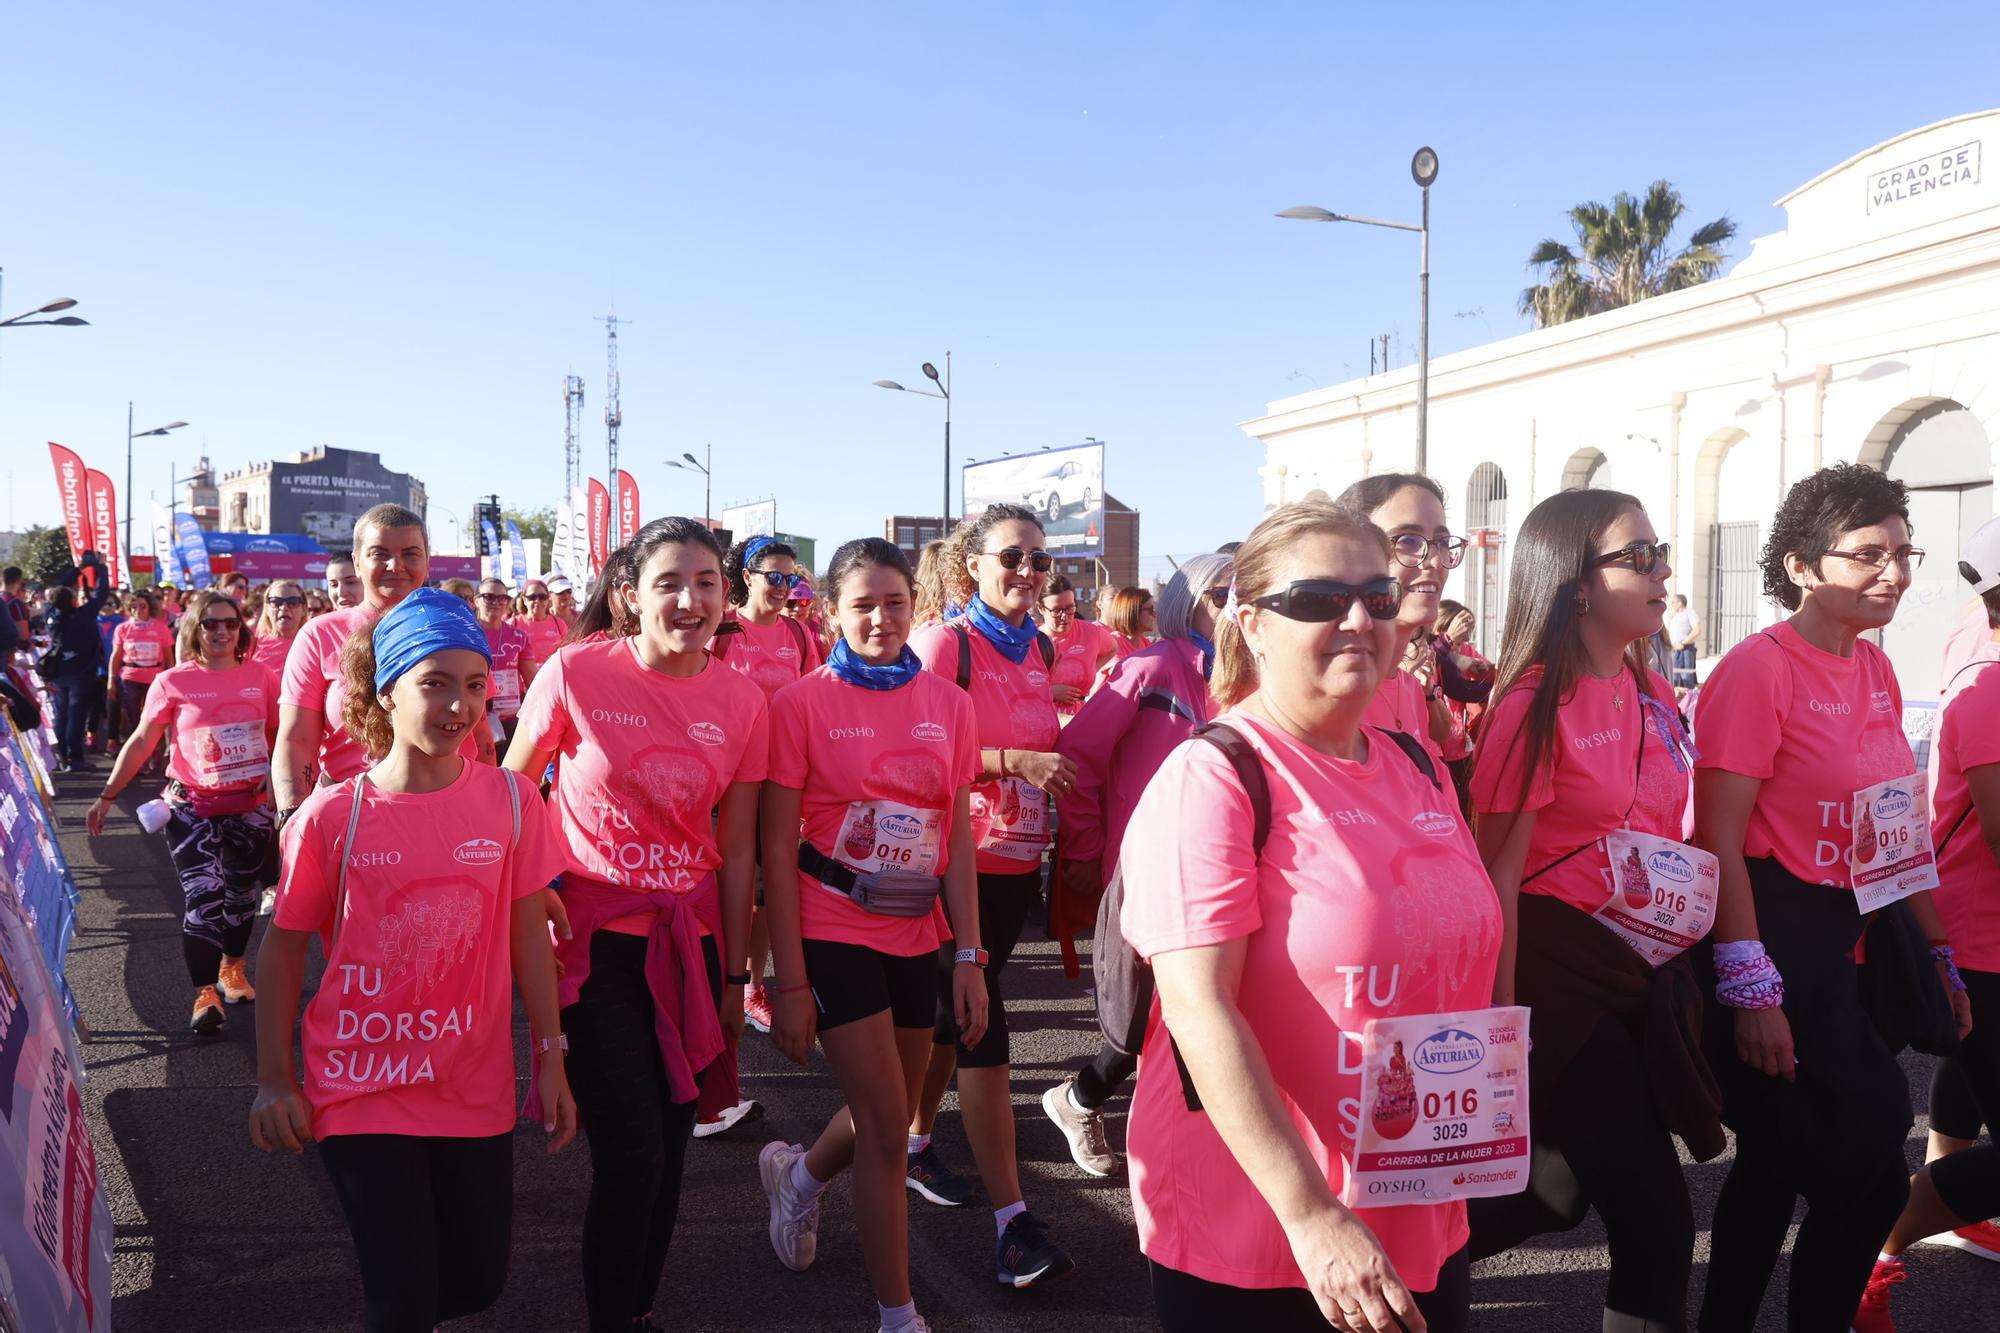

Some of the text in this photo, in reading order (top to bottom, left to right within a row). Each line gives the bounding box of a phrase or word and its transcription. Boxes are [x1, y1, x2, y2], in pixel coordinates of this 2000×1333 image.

[1877, 150, 1969, 189] GRAO DE
[1873, 167, 1971, 207] VALENCIA
[294, 475, 329, 487] PUERTO
[591, 708, 647, 728] OYSHO
[829, 727, 875, 740] OYSHO
[1574, 727, 1621, 750] OYSHO
[223, 744, 247, 756] 016
[1021, 806, 1039, 819] 016
[1879, 826, 1908, 848] 016
[350, 850, 402, 867] YSHO
[876, 843, 913, 862] 016
[1651, 856, 1692, 879] ASTURIANA
[1654, 886, 1687, 913] 016
[1615, 914, 1647, 932] CARRERA
[1646, 927, 1655, 936] DE
[1655, 930, 1664, 939] LA
[1654, 911, 1675, 926] 3028
[339, 964, 382, 996] TU
[1335, 963, 1400, 1008] TU
[1489, 1032, 1517, 1045] SUMA
[1420, 1047, 1480, 1064] ASTURIANA
[324, 1050, 435, 1085] SUMA
[1424, 1088, 1478, 1119] 016
[1433, 1122, 1468, 1141] 3029
[1378, 1143, 1515, 1167] CARRERA DE LA MUJER 2023
[1467, 1168, 1518, 1184] Santander
[1368, 1179, 1425, 1195] OYSHO
